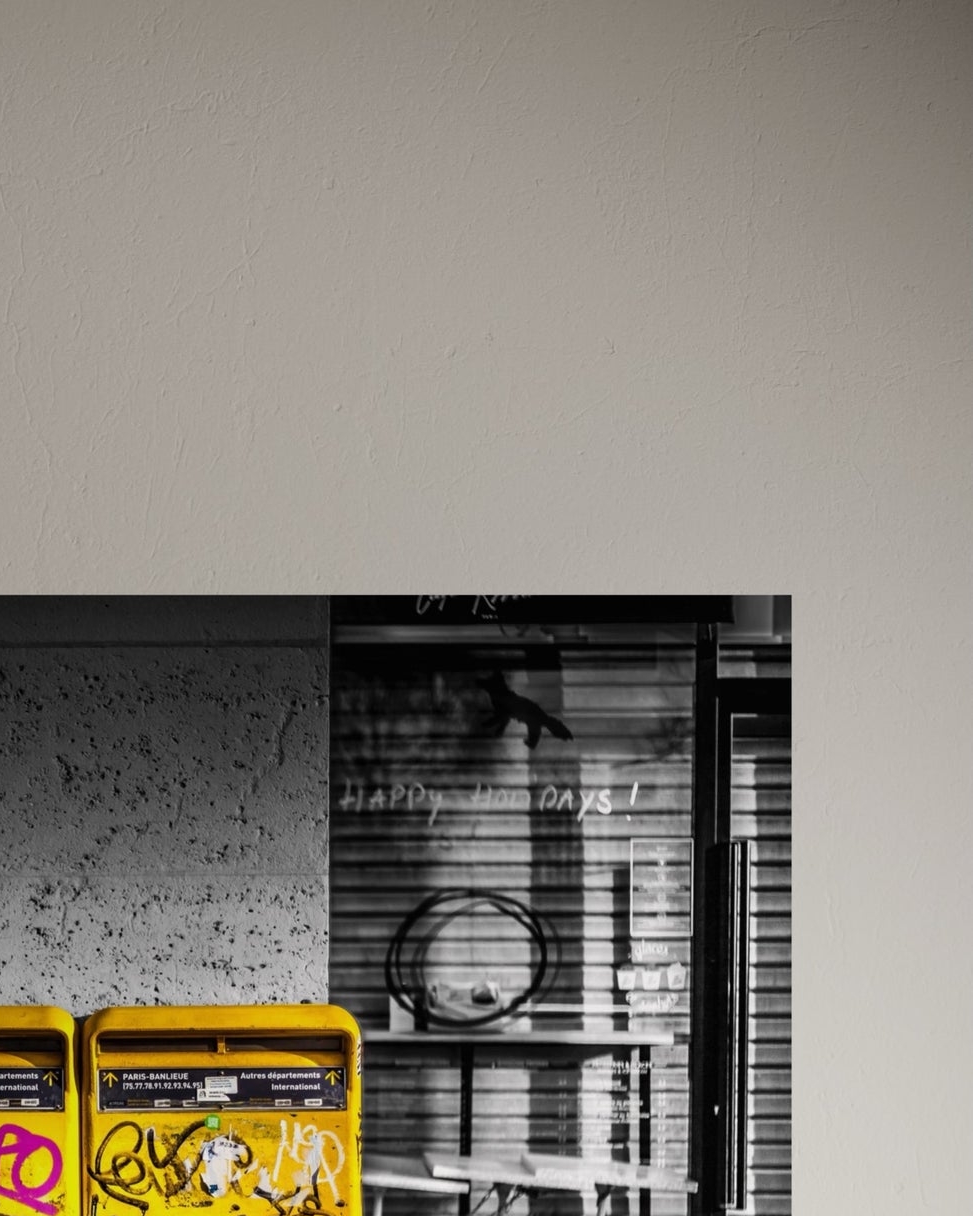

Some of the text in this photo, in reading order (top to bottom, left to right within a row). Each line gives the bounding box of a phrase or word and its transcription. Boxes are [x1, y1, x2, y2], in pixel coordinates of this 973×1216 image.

[240, 1071, 321, 1081] Autres départements
[271, 1083, 321, 1091] International
